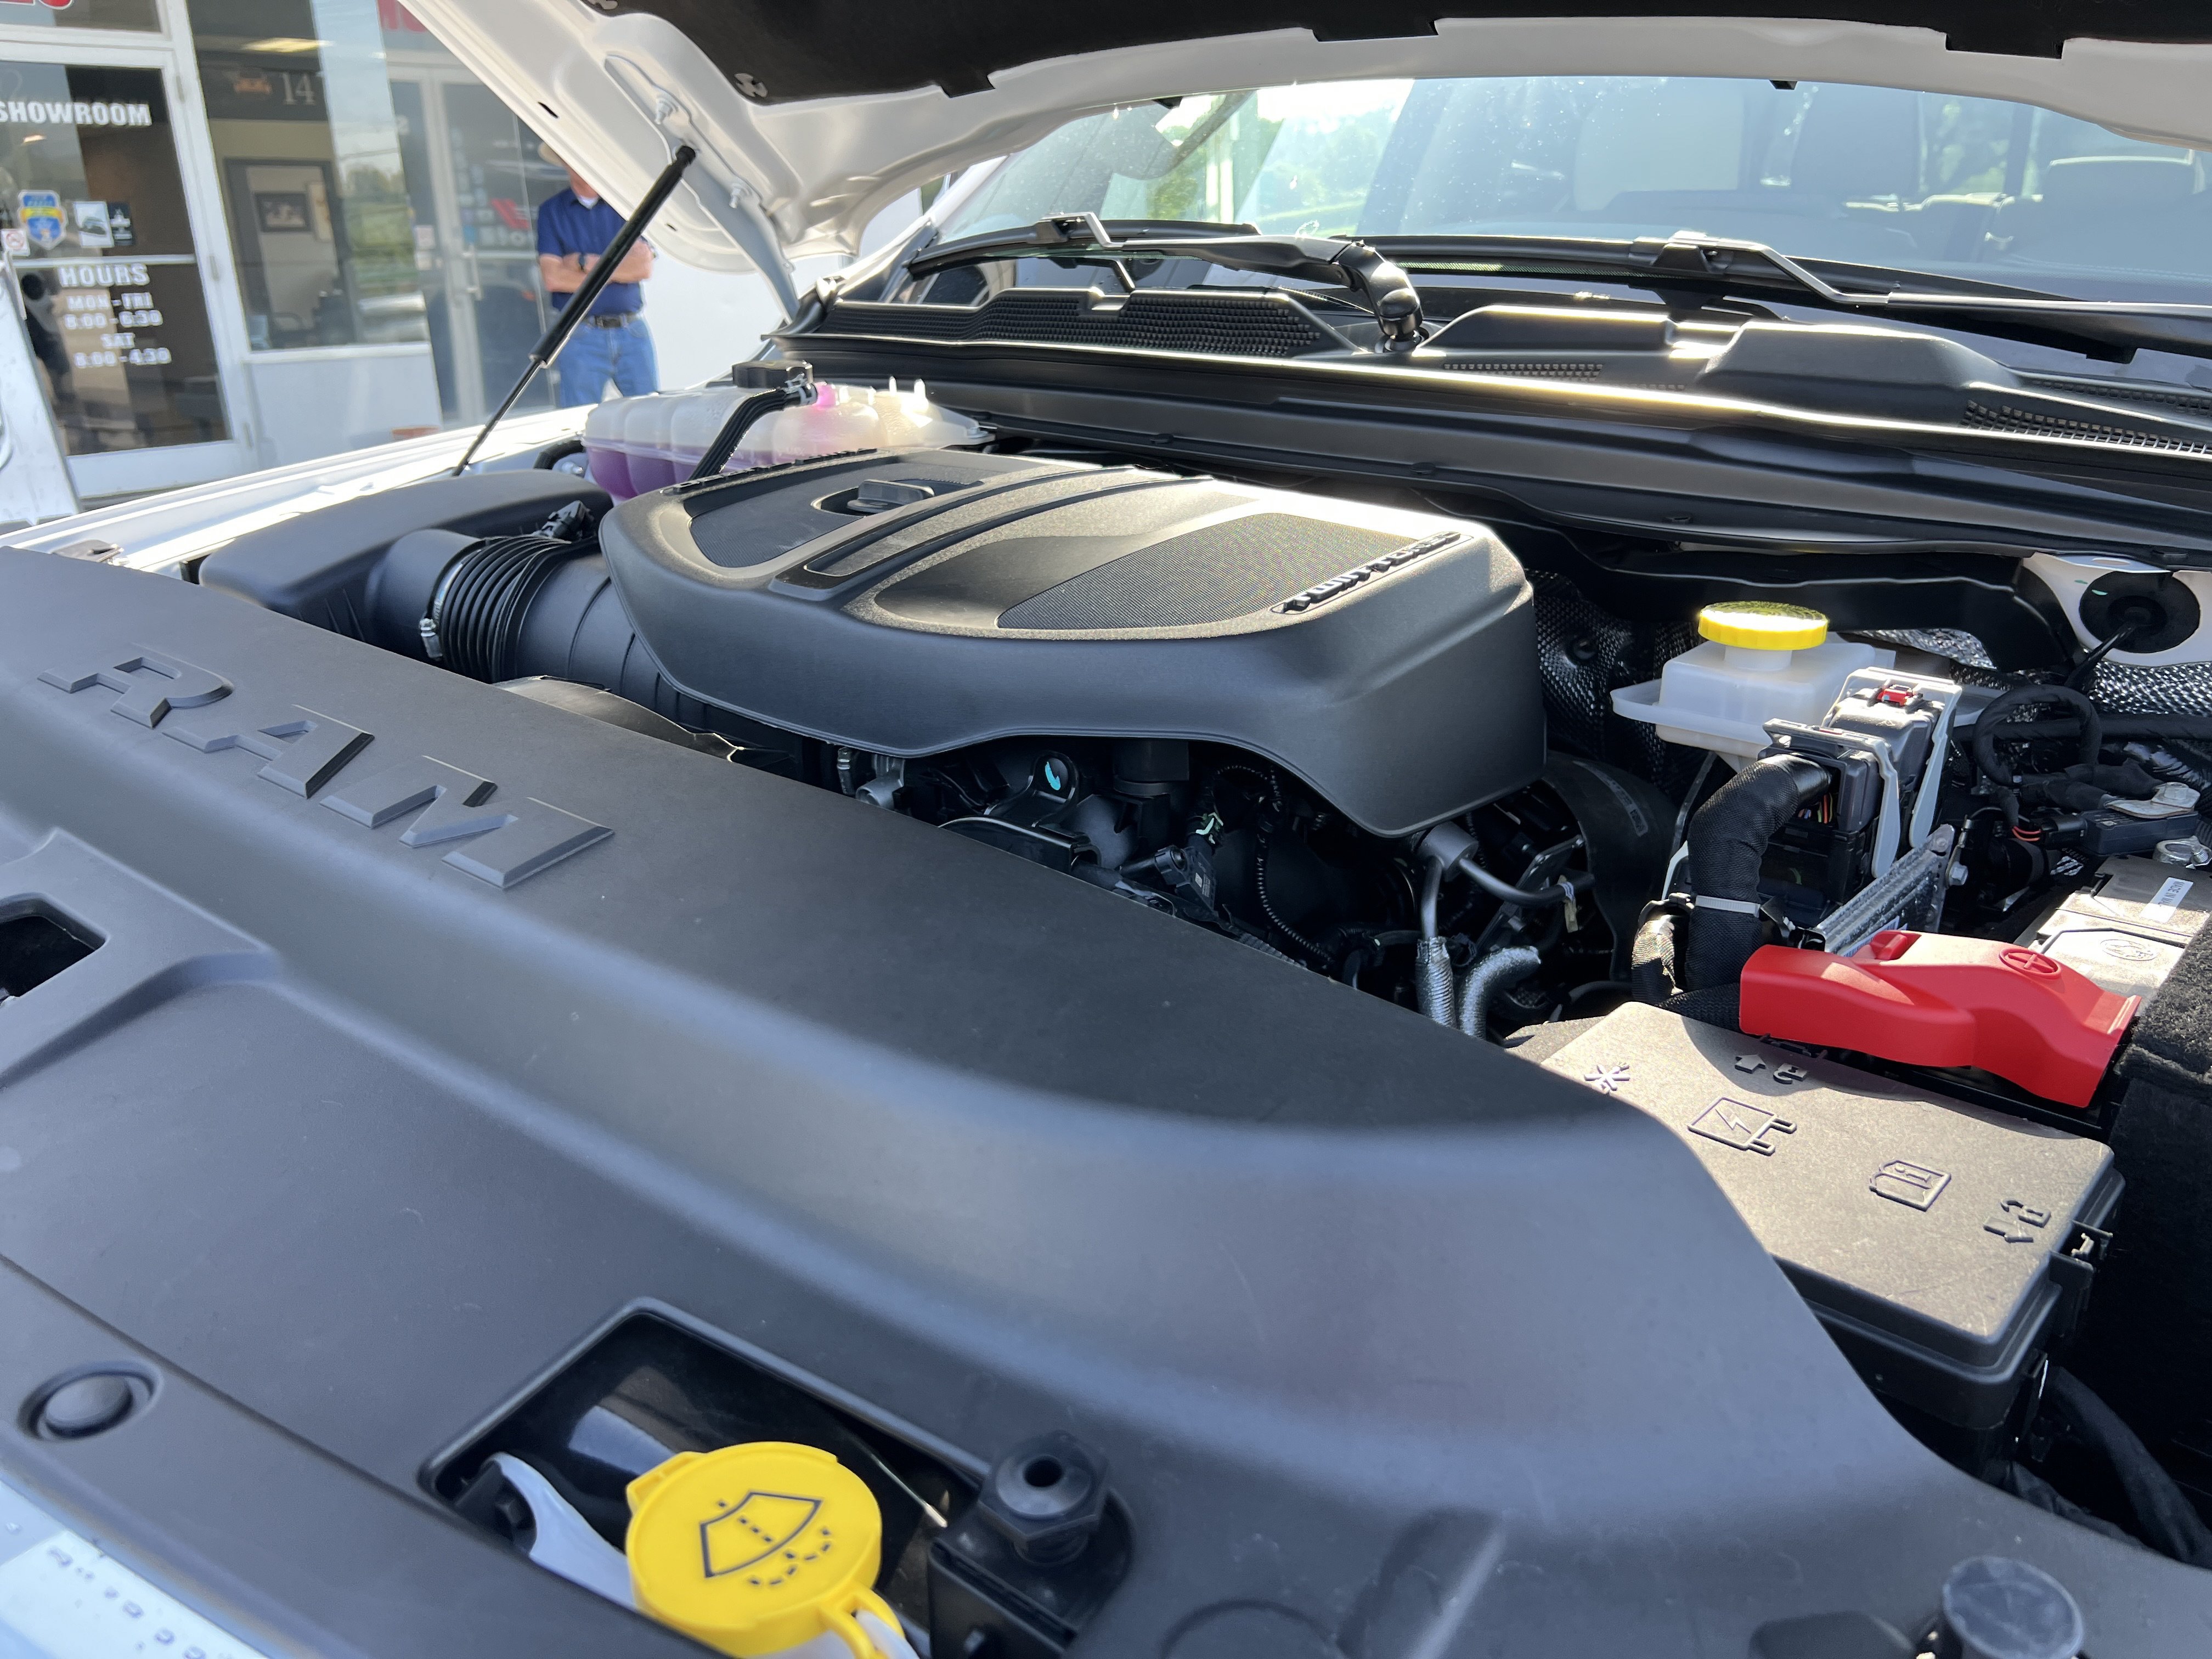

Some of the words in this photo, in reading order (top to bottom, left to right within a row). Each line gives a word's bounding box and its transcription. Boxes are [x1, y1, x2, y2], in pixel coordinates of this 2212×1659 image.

[280, 72, 315, 105] 14
[57, 263, 150, 287] HOURS
[101, 332, 136, 349] SAT
[38, 642, 614, 888] RAM
